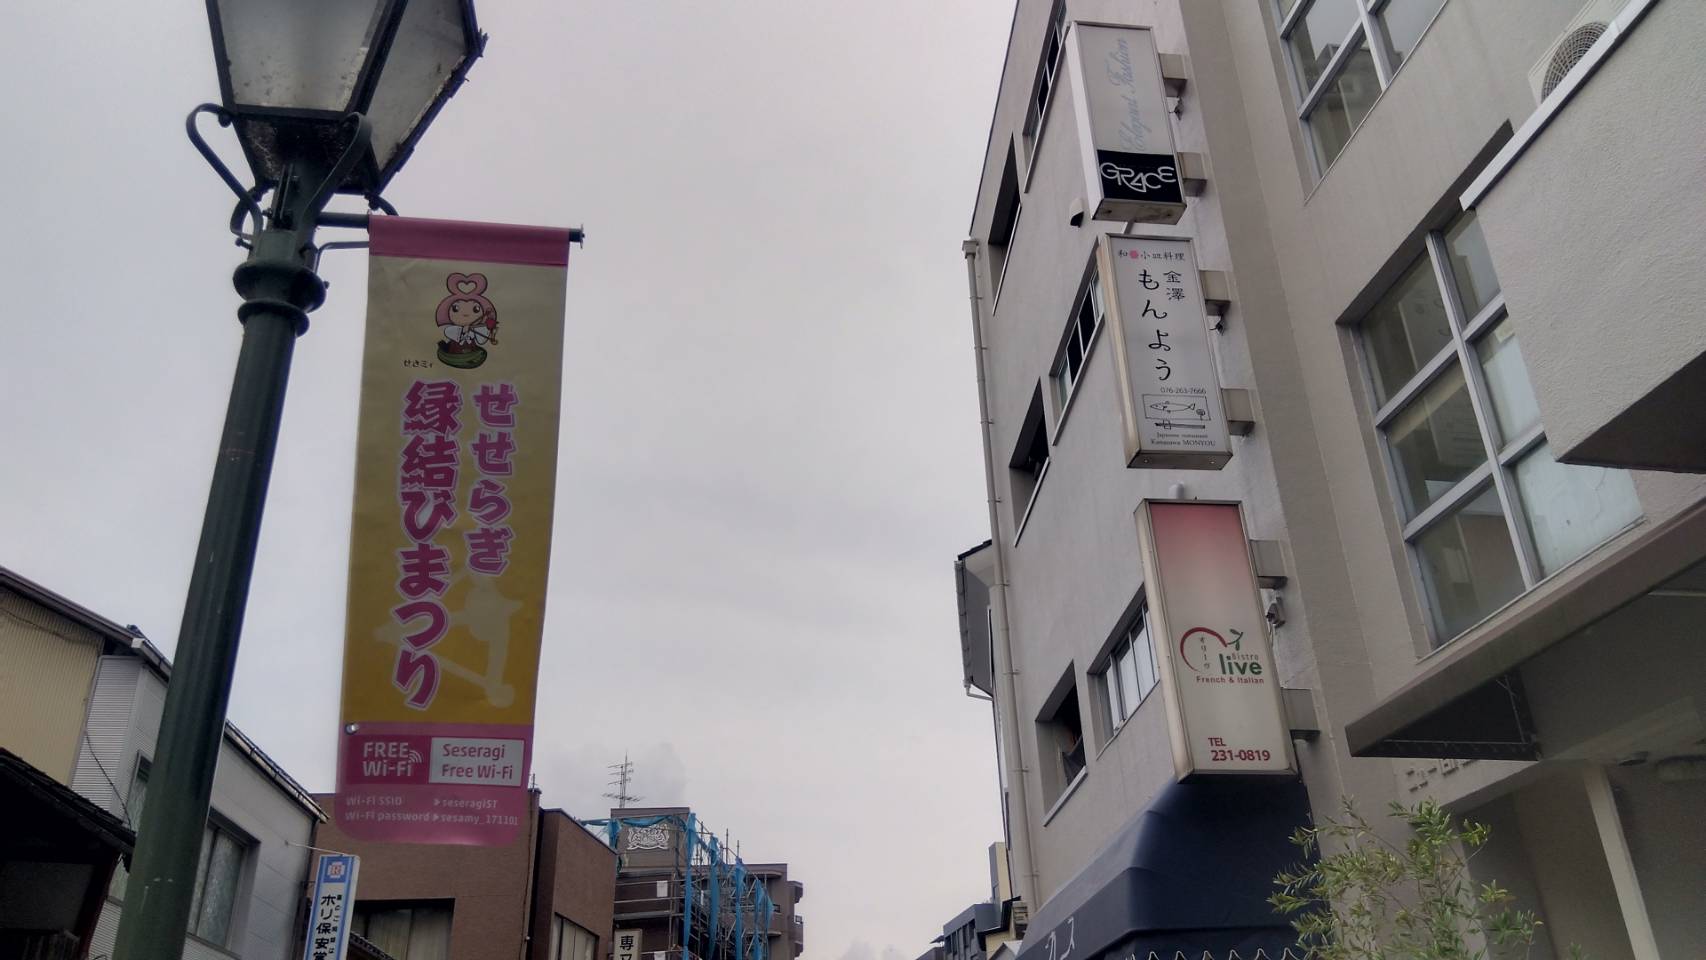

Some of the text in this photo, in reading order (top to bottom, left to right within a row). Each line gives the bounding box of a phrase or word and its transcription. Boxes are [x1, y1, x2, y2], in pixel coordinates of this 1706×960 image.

[1100, 162, 1176, 193] GRACE
[1163, 270, 1186, 301] 金澤
[1138, 269, 1171, 381] もんよう
[1183, 439, 1216, 447] MONYOU
[464, 382, 519, 577] せせらぎ
[391, 379, 463, 712] 縁結びまつり
[1196, 675, 1264, 684] French & Italian
[363, 742, 409, 758] FREE
[1208, 737, 1226, 747] TEL
[442, 743, 506, 761] Seseragi
[1211, 750, 1271, 762] 231-0819
[363, 760, 412, 777] Wi-Fi
[441, 764, 514, 780] Free Wi-Fi
[346, 796, 376, 806] Wi-Fi
[345, 811, 375, 821] Wi-Fi
[377, 811, 431, 823] password
